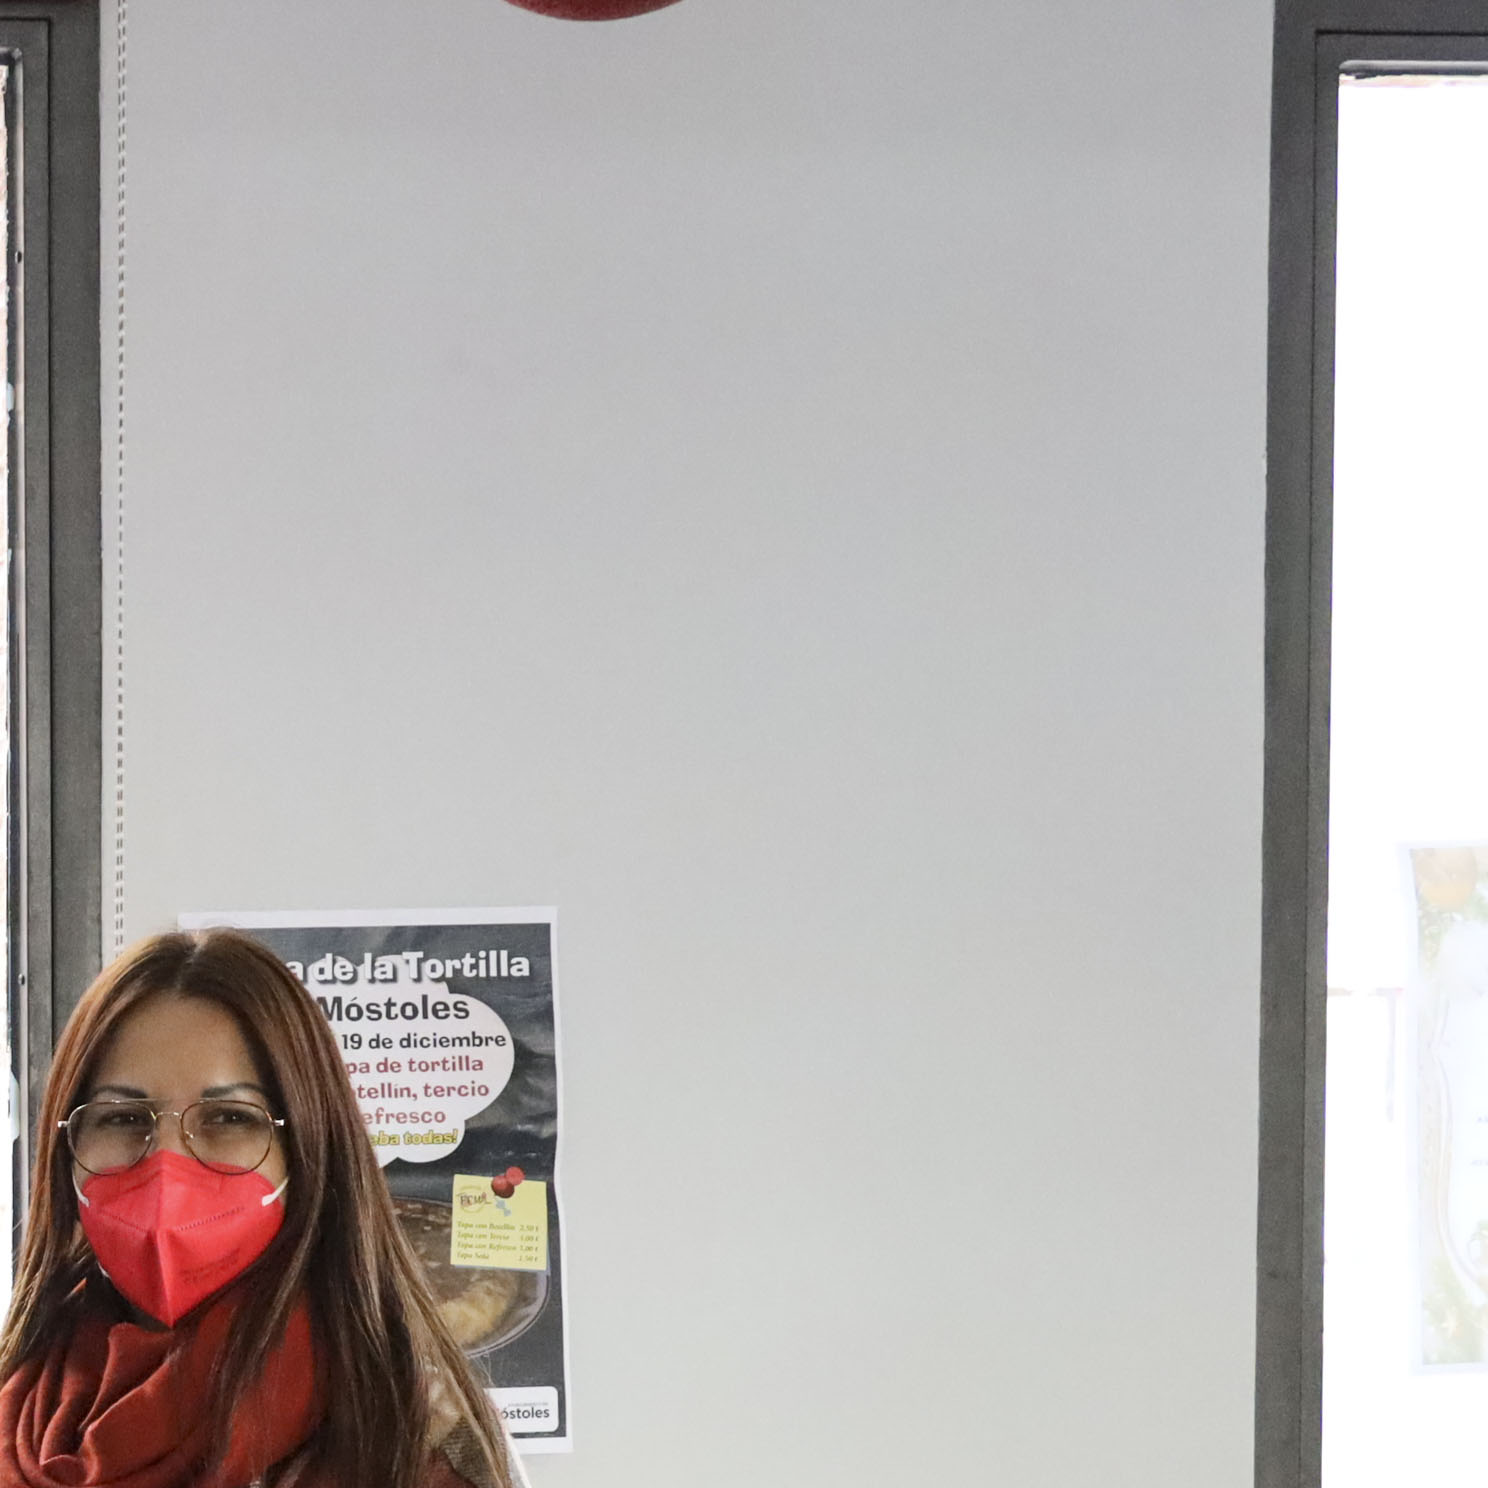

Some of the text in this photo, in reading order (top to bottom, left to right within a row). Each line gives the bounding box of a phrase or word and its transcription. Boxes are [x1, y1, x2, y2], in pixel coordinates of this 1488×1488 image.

[313, 953, 354, 980] de
[364, 953, 393, 980] la
[402, 950, 530, 980] Tortilla
[316, 994, 470, 1022] Móstoles
[342, 1031, 506, 1050] 19 de diciembre
[376, 1058, 402, 1074] de
[408, 1056, 484, 1072] tortilla
[424, 1082, 489, 1098] tercio
[362, 1107, 446, 1125] efresco
[403, 1130, 458, 1146] todas!
